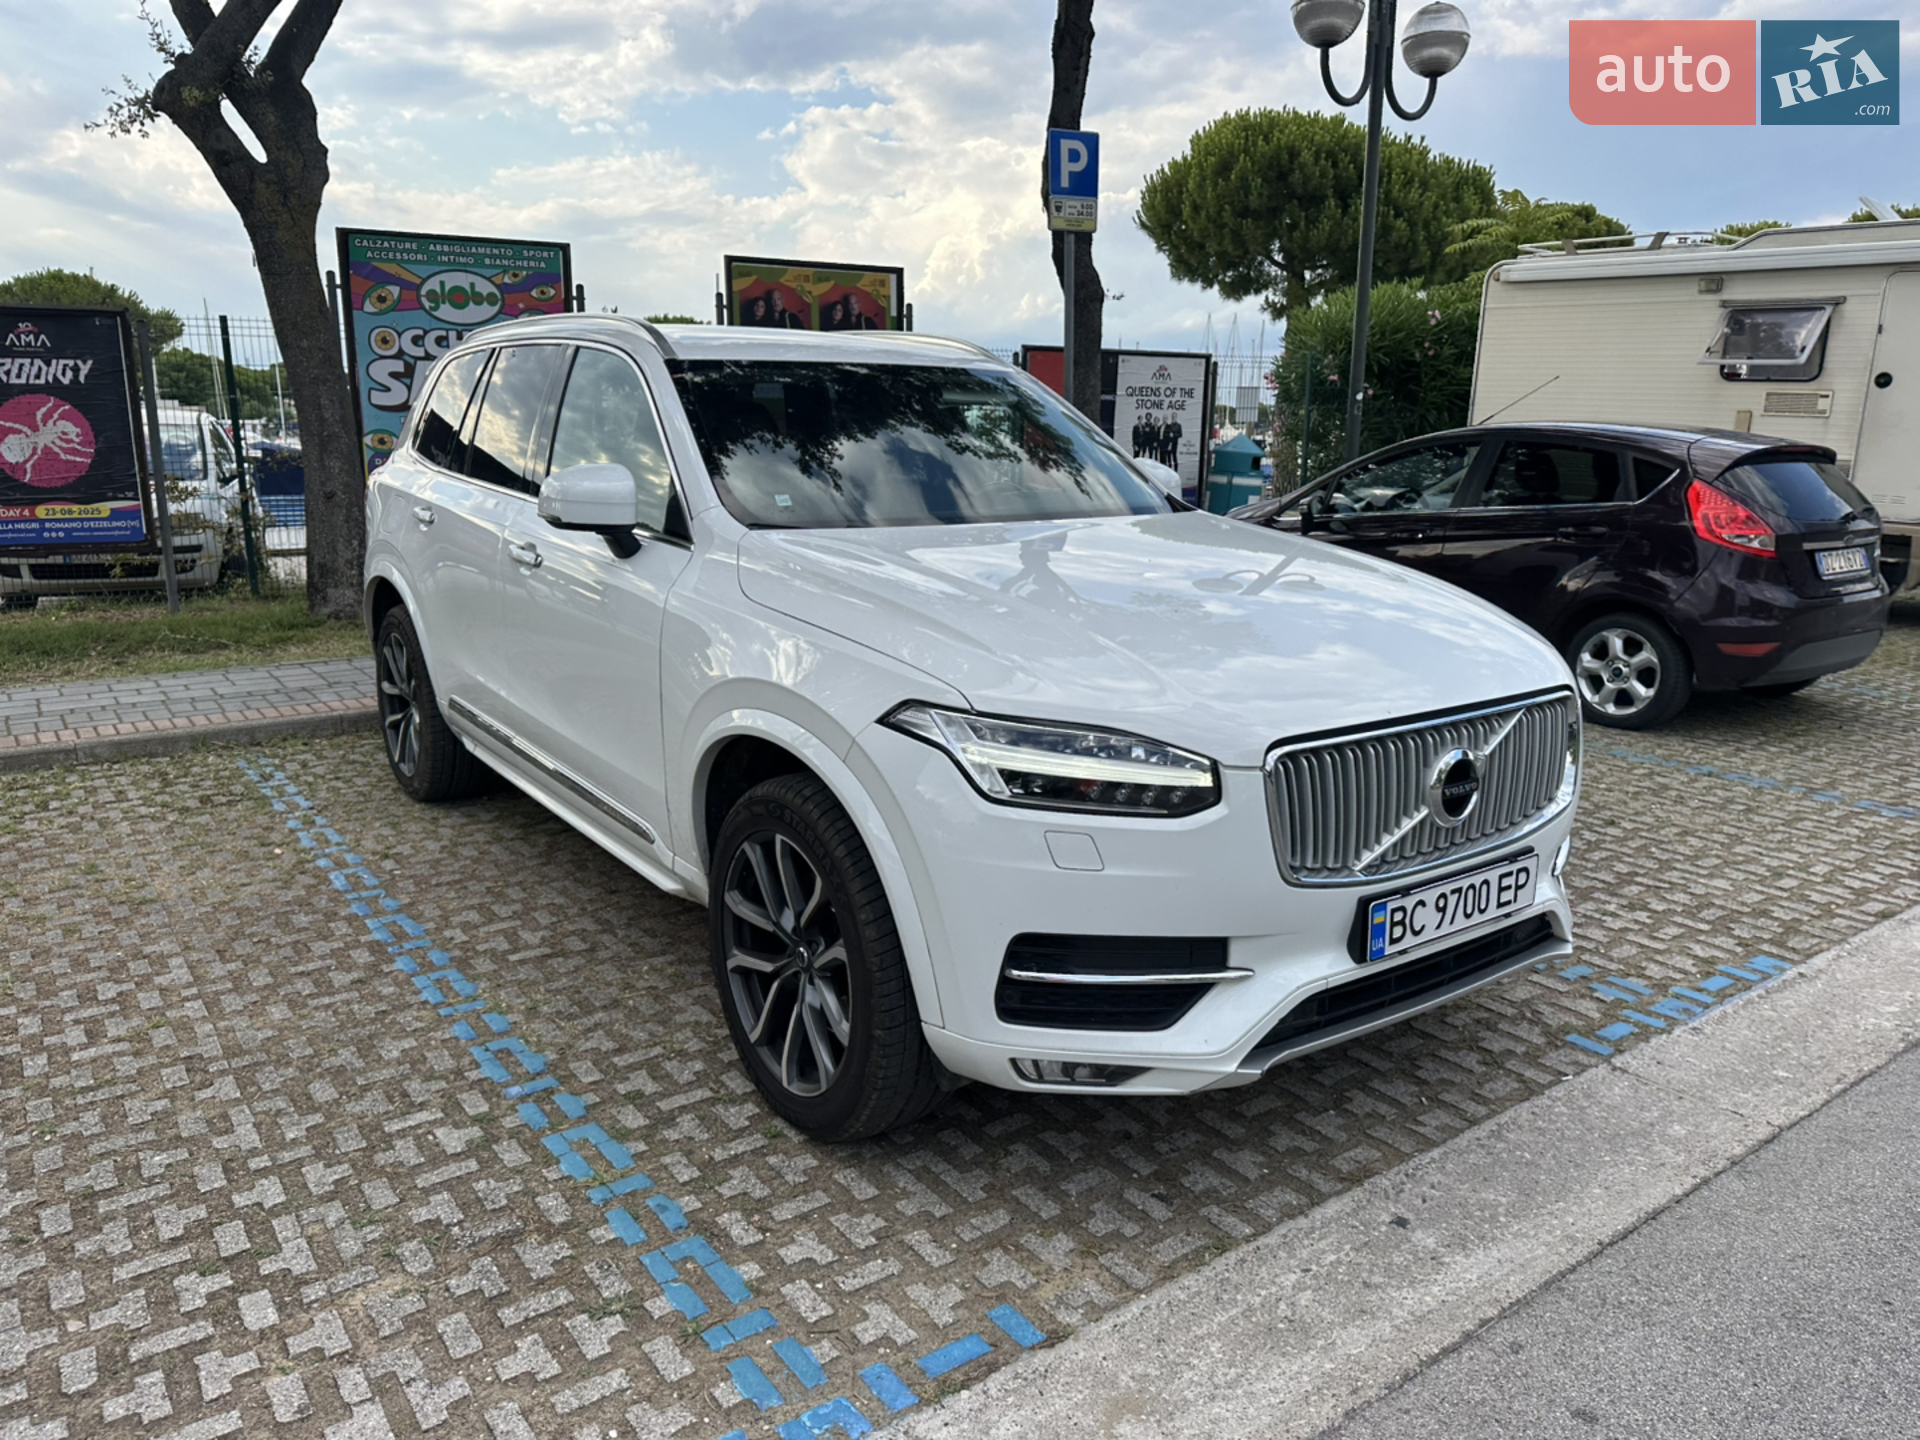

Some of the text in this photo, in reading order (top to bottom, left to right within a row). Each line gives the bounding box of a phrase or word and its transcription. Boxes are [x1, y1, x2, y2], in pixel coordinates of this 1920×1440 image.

[1060, 138, 1088, 188] P
[354, 238, 555, 259] CALZATURE ABBIGLIAMENTO SPORT
[366, 250, 547, 269] ACCESSORI INTIMO BIANCHERIA
[425, 280, 501, 312] globo
[5, 333, 51, 347] AMA
[1151, 372, 1172, 381] AMA
[1125, 385, 1161, 398] QUEENS
[1163, 387, 1178, 398] OF
[1179, 387, 1195, 399] THE
[1135, 398, 1186, 411] STONE AGE
[0, 507, 102, 517] DAY 4 23-08-2025
[14, 522, 40, 530] NEGRI
[45, 521, 82, 529] ROMANO
[1443, 781, 1478, 797] VOLVO
[1388, 865, 1531, 946] BC 9700 EP
[1371, 936, 1384, 951] UA
